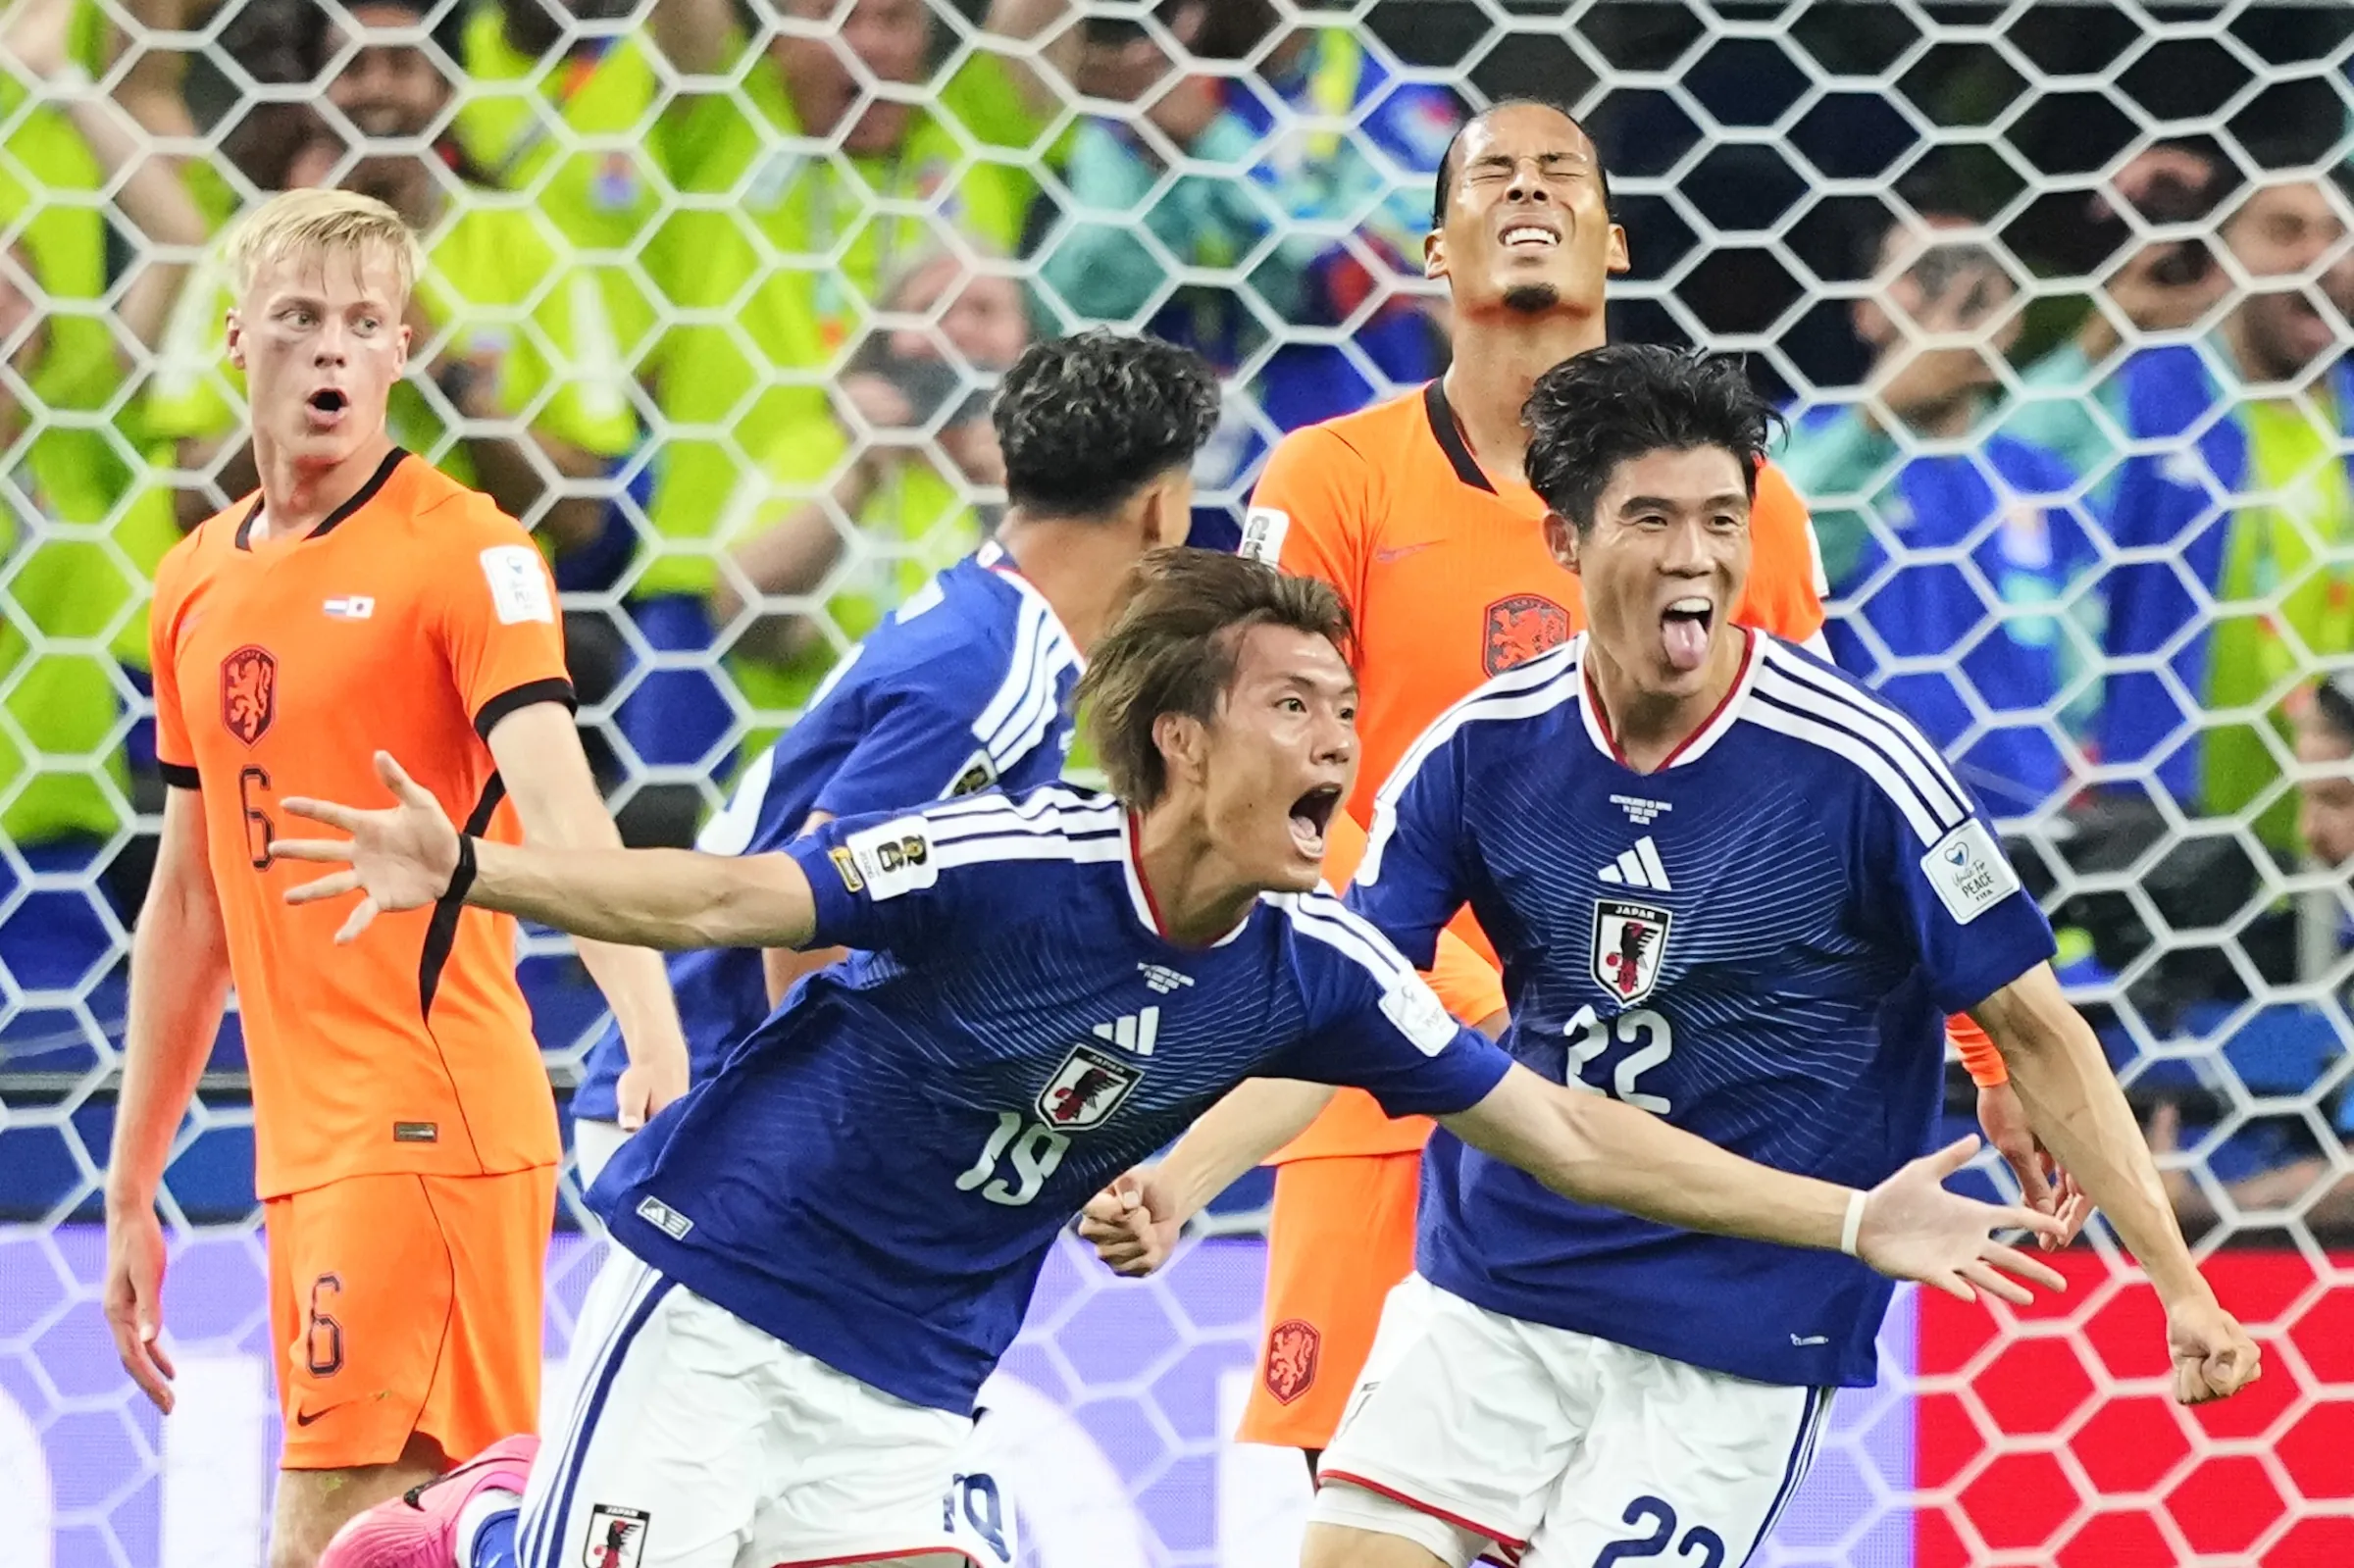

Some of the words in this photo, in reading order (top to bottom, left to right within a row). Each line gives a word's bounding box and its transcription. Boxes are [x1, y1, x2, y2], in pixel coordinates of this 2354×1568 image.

[238, 763, 275, 873] 6
[1614, 905, 1657, 921] JAPAN
[1961, 872, 1994, 899] PEACE
[1087, 1054, 1127, 1076] JAPAN
[1563, 1003, 1673, 1115] 22
[954, 1111, 1072, 1207] 19
[306, 1272, 344, 1379] 6
